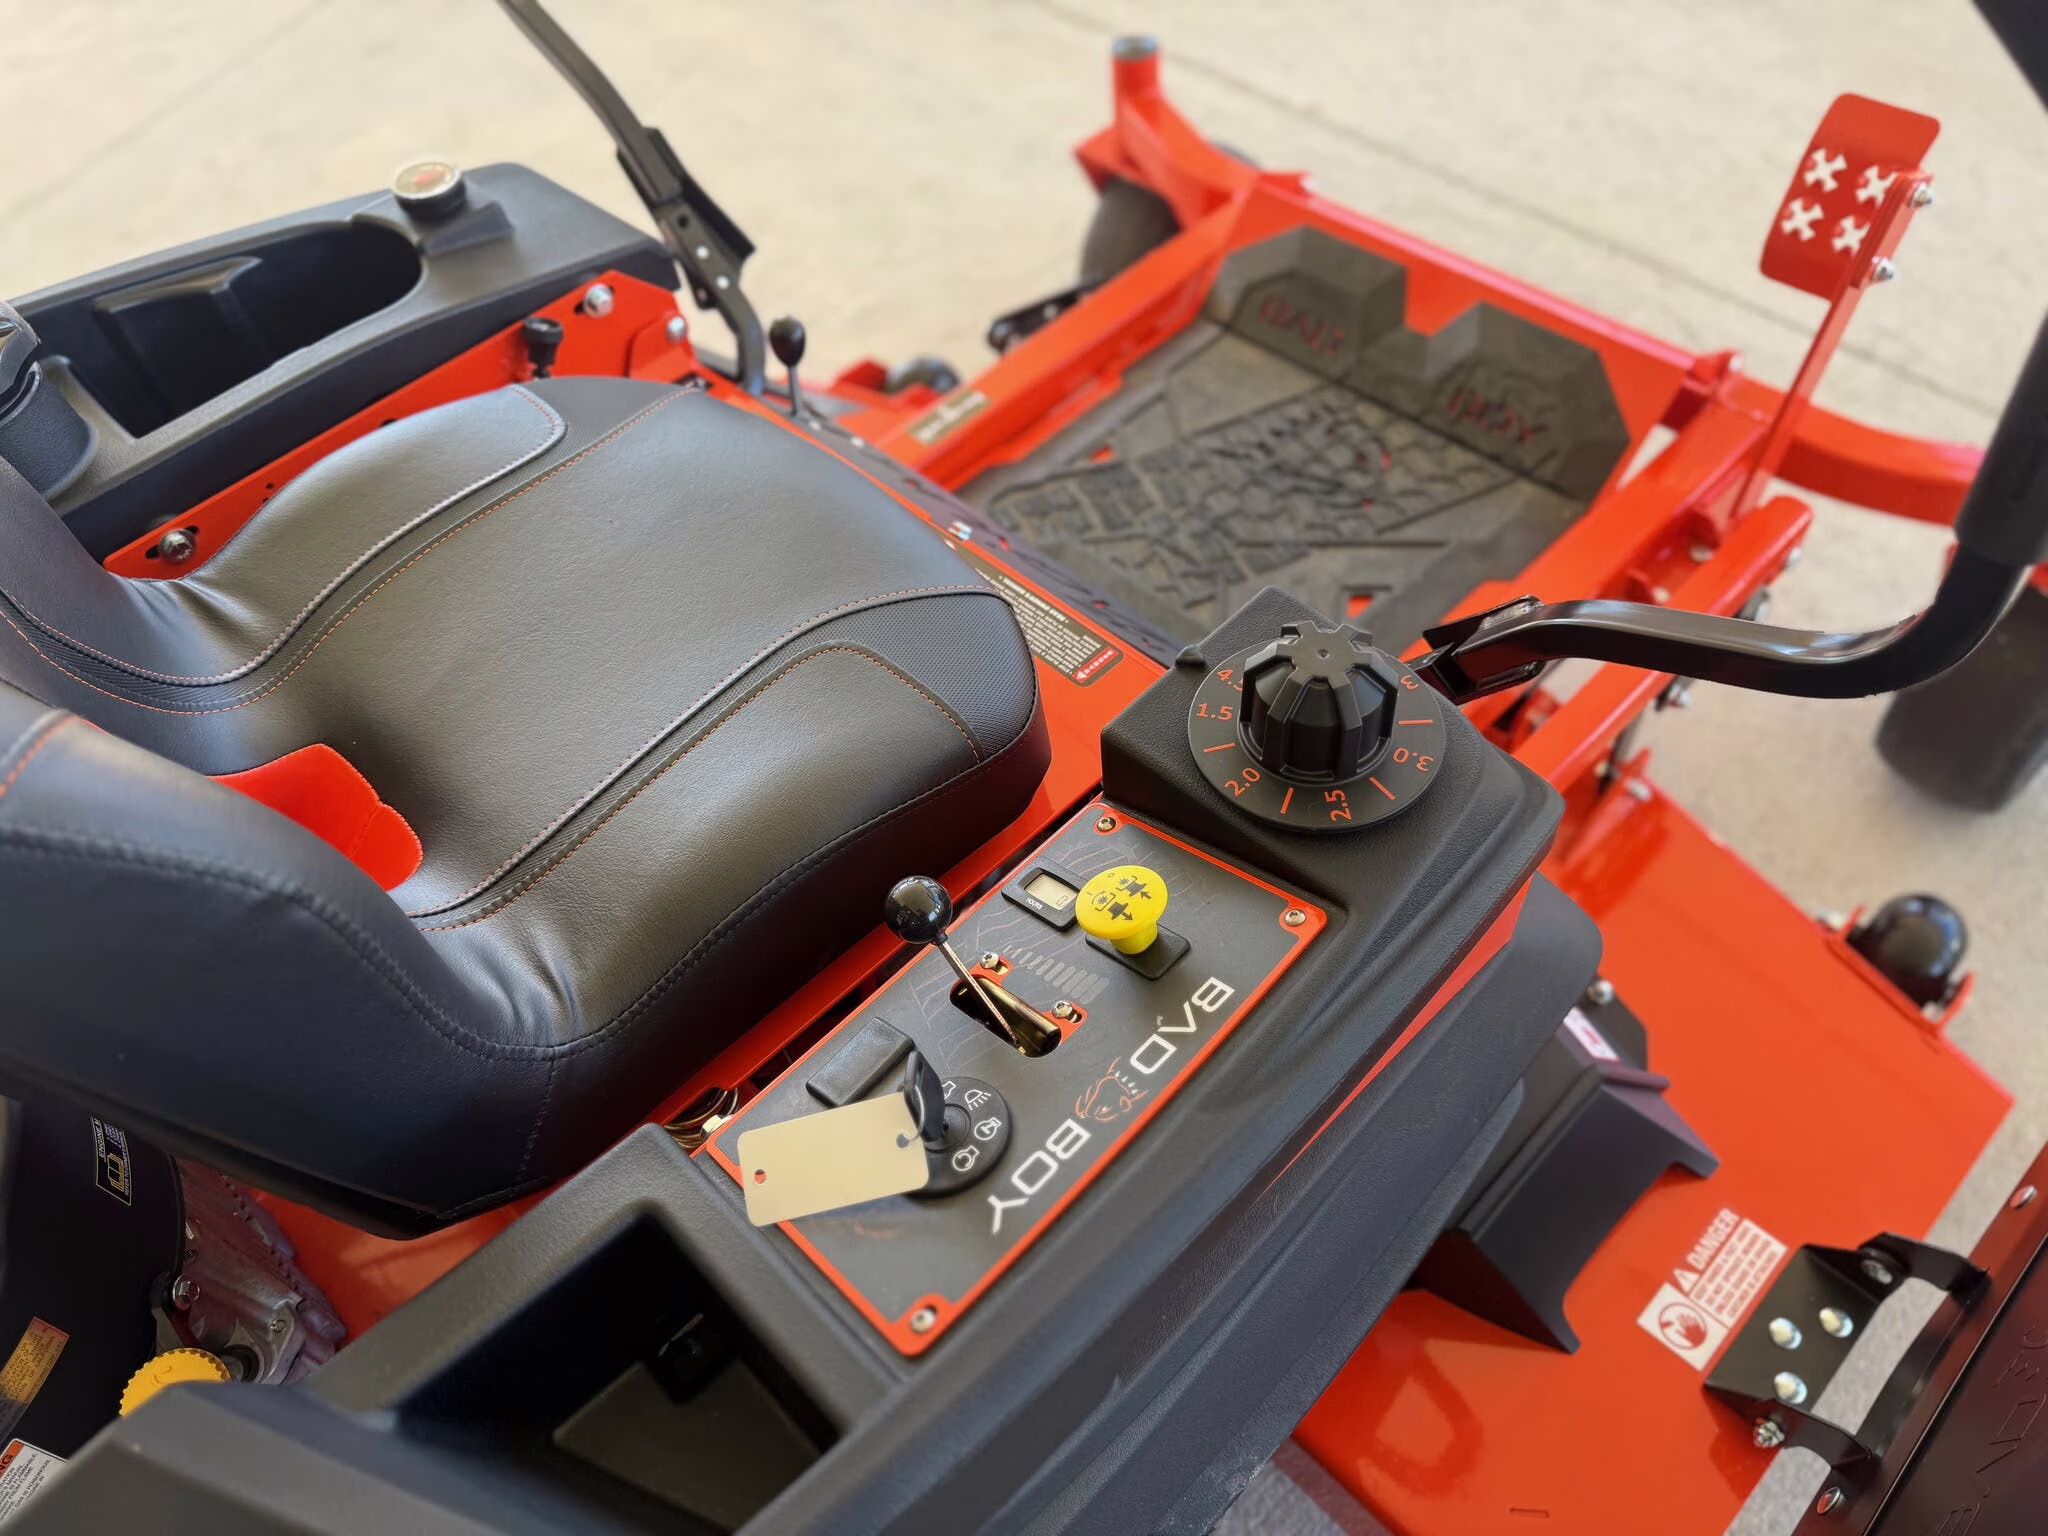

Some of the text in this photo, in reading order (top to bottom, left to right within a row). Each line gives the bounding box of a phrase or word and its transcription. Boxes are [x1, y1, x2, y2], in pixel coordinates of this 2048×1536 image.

[1196, 703, 1233, 721] 1.5
[1393, 747, 1434, 772] 3.0
[1225, 767, 1261, 797] 2.0
[1325, 789, 1352, 822] 2.5
[988, 976, 1235, 1235] BAD BOY
[1686, 1207, 1740, 1272] DANGER
